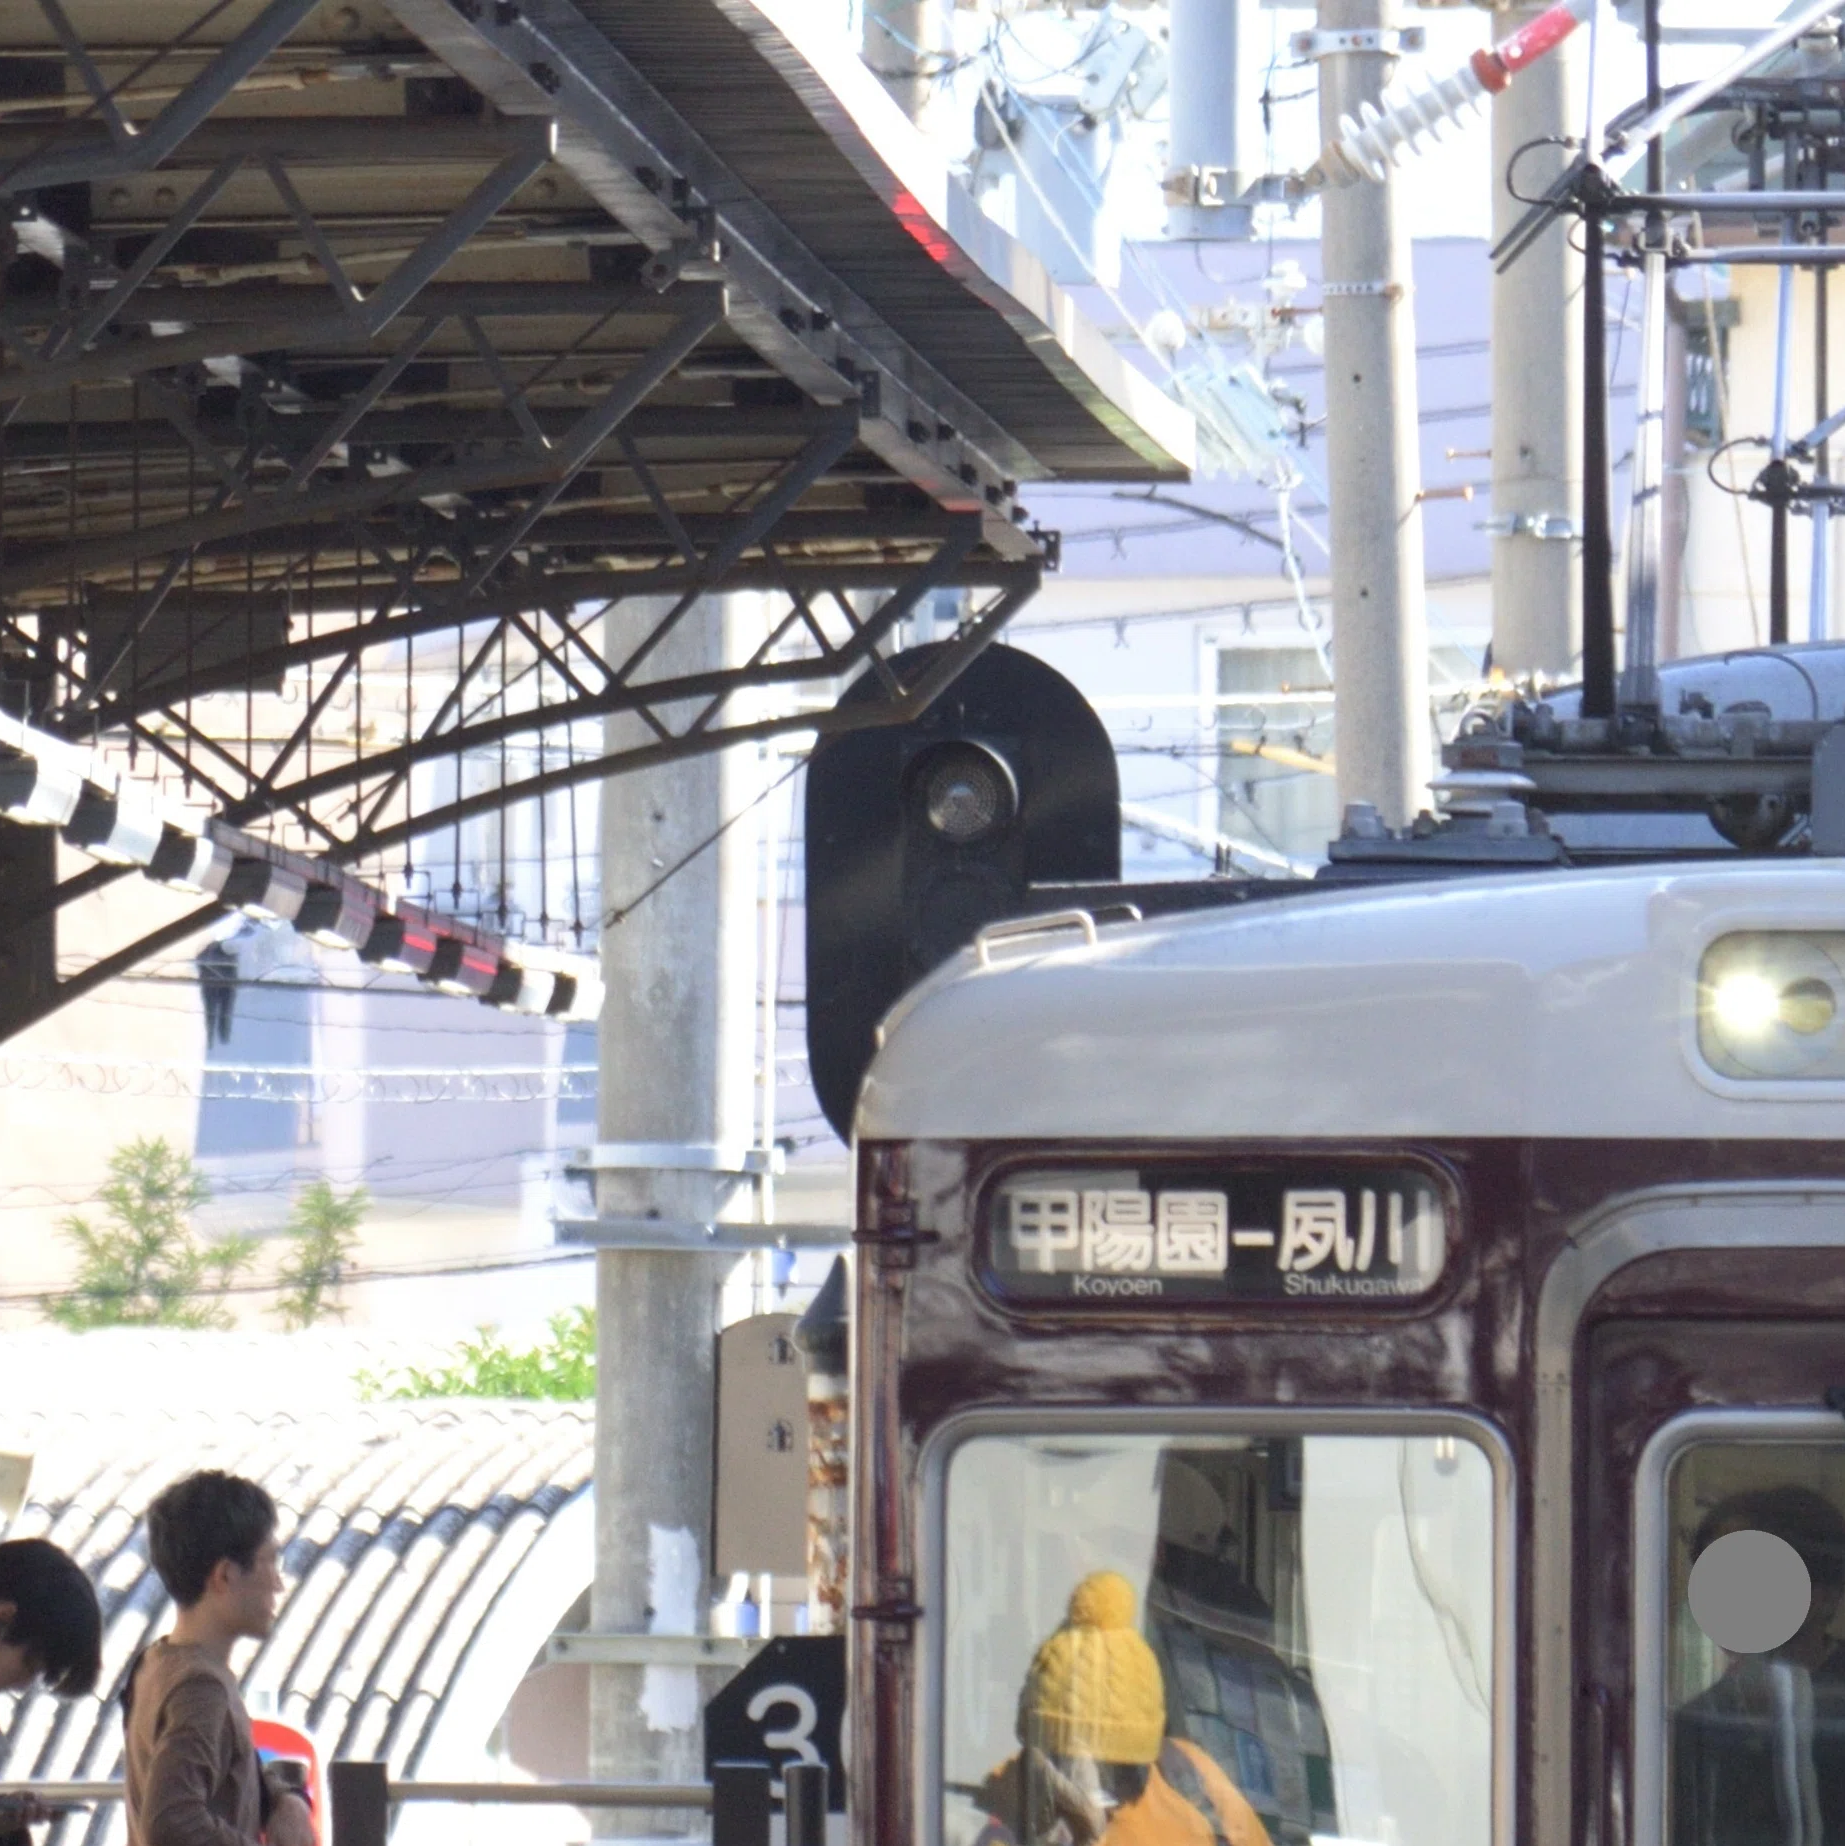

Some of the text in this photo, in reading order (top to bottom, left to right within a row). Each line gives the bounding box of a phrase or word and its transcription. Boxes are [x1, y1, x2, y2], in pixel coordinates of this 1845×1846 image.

[1073, 1273, 1425, 1298] Koyoen Shukugawa
[747, 1684, 851, 1799] 3
